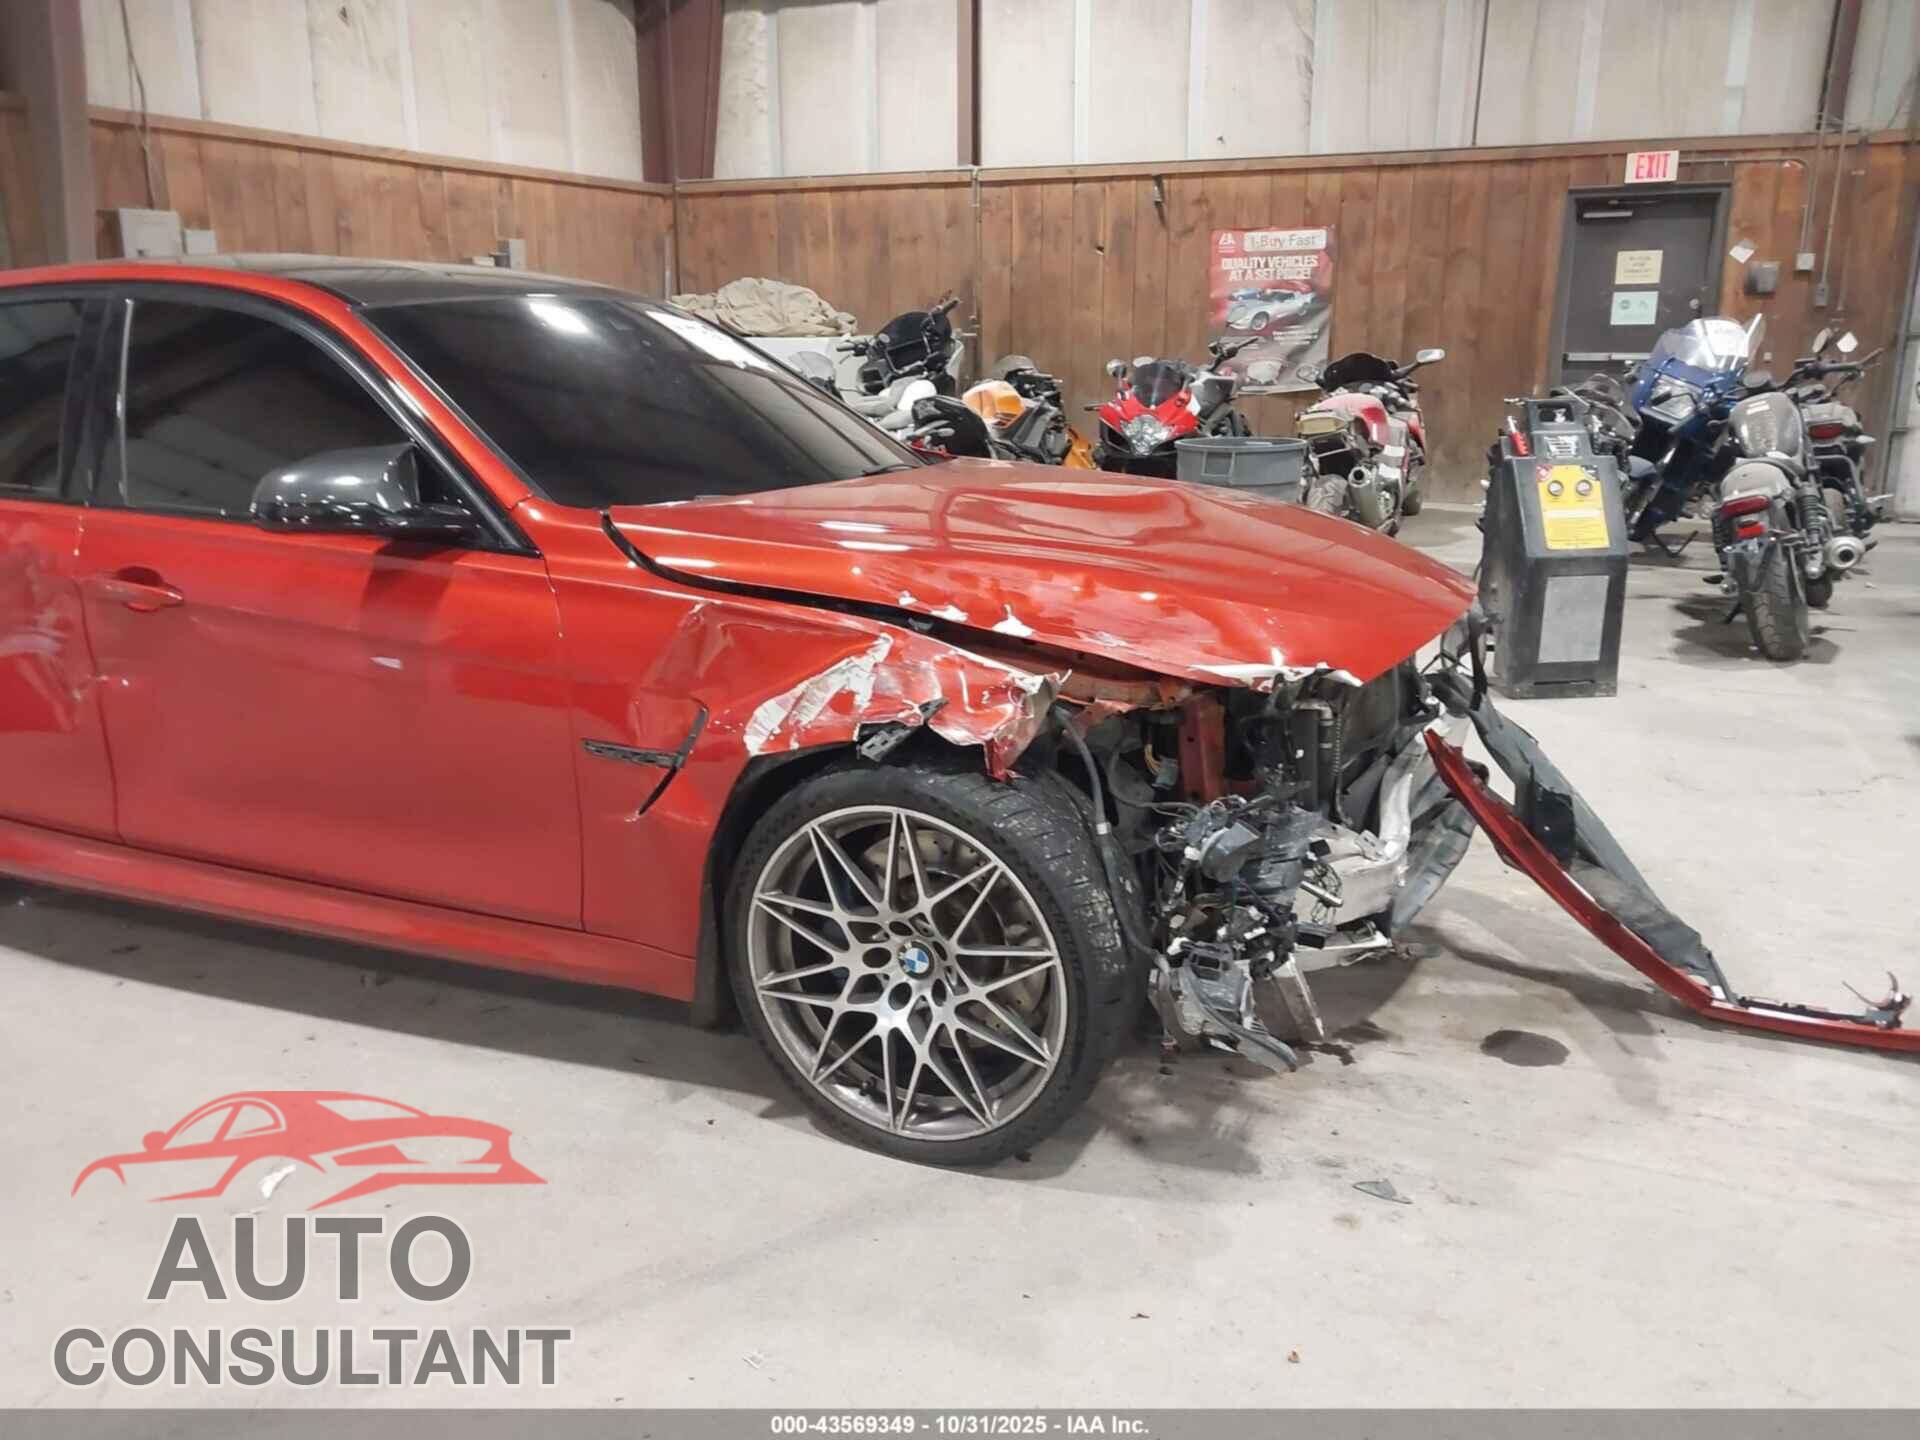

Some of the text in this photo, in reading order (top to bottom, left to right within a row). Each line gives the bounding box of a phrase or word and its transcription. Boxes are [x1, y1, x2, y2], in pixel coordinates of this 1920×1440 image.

[1635, 152, 1671, 179] EXIT
[1288, 234, 1316, 246] Fast
[1221, 254, 1319, 270] QUALITY VEHICLES
[1229, 269, 1244, 281] AT
[1244, 269, 1254, 281] A
[1255, 268, 1276, 280] SET
